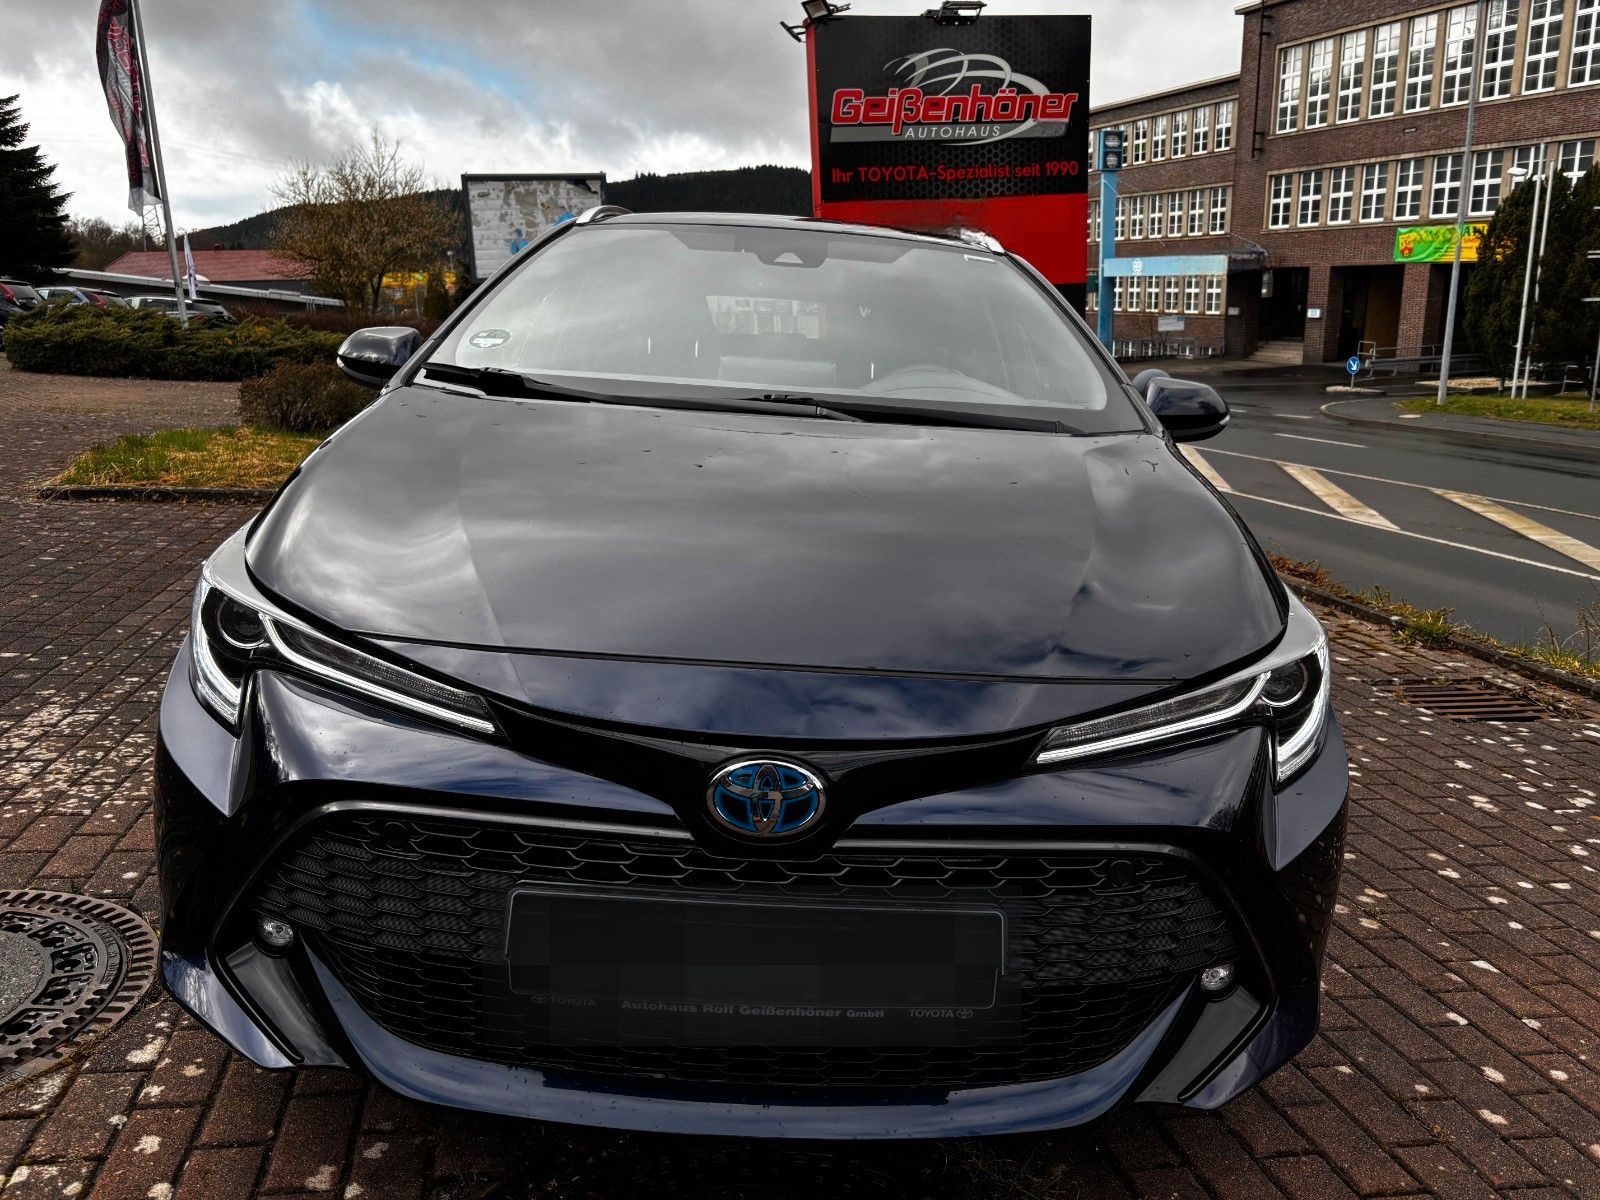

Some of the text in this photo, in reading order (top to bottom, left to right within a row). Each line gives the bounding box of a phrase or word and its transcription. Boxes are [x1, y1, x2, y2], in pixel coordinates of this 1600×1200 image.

[831, 84, 1078, 135] Geißenhöner
[904, 125, 1001, 139] AUTOHAUS
[832, 161, 1079, 184] Ihr TOYOTA-Spezialist seit 1990
[550, 997, 596, 1007] TOYOTA
[621, 999, 884, 1018] Autohaus Rolf Geißenhöner GmbH
[908, 1008, 954, 1018] TOYOTA
